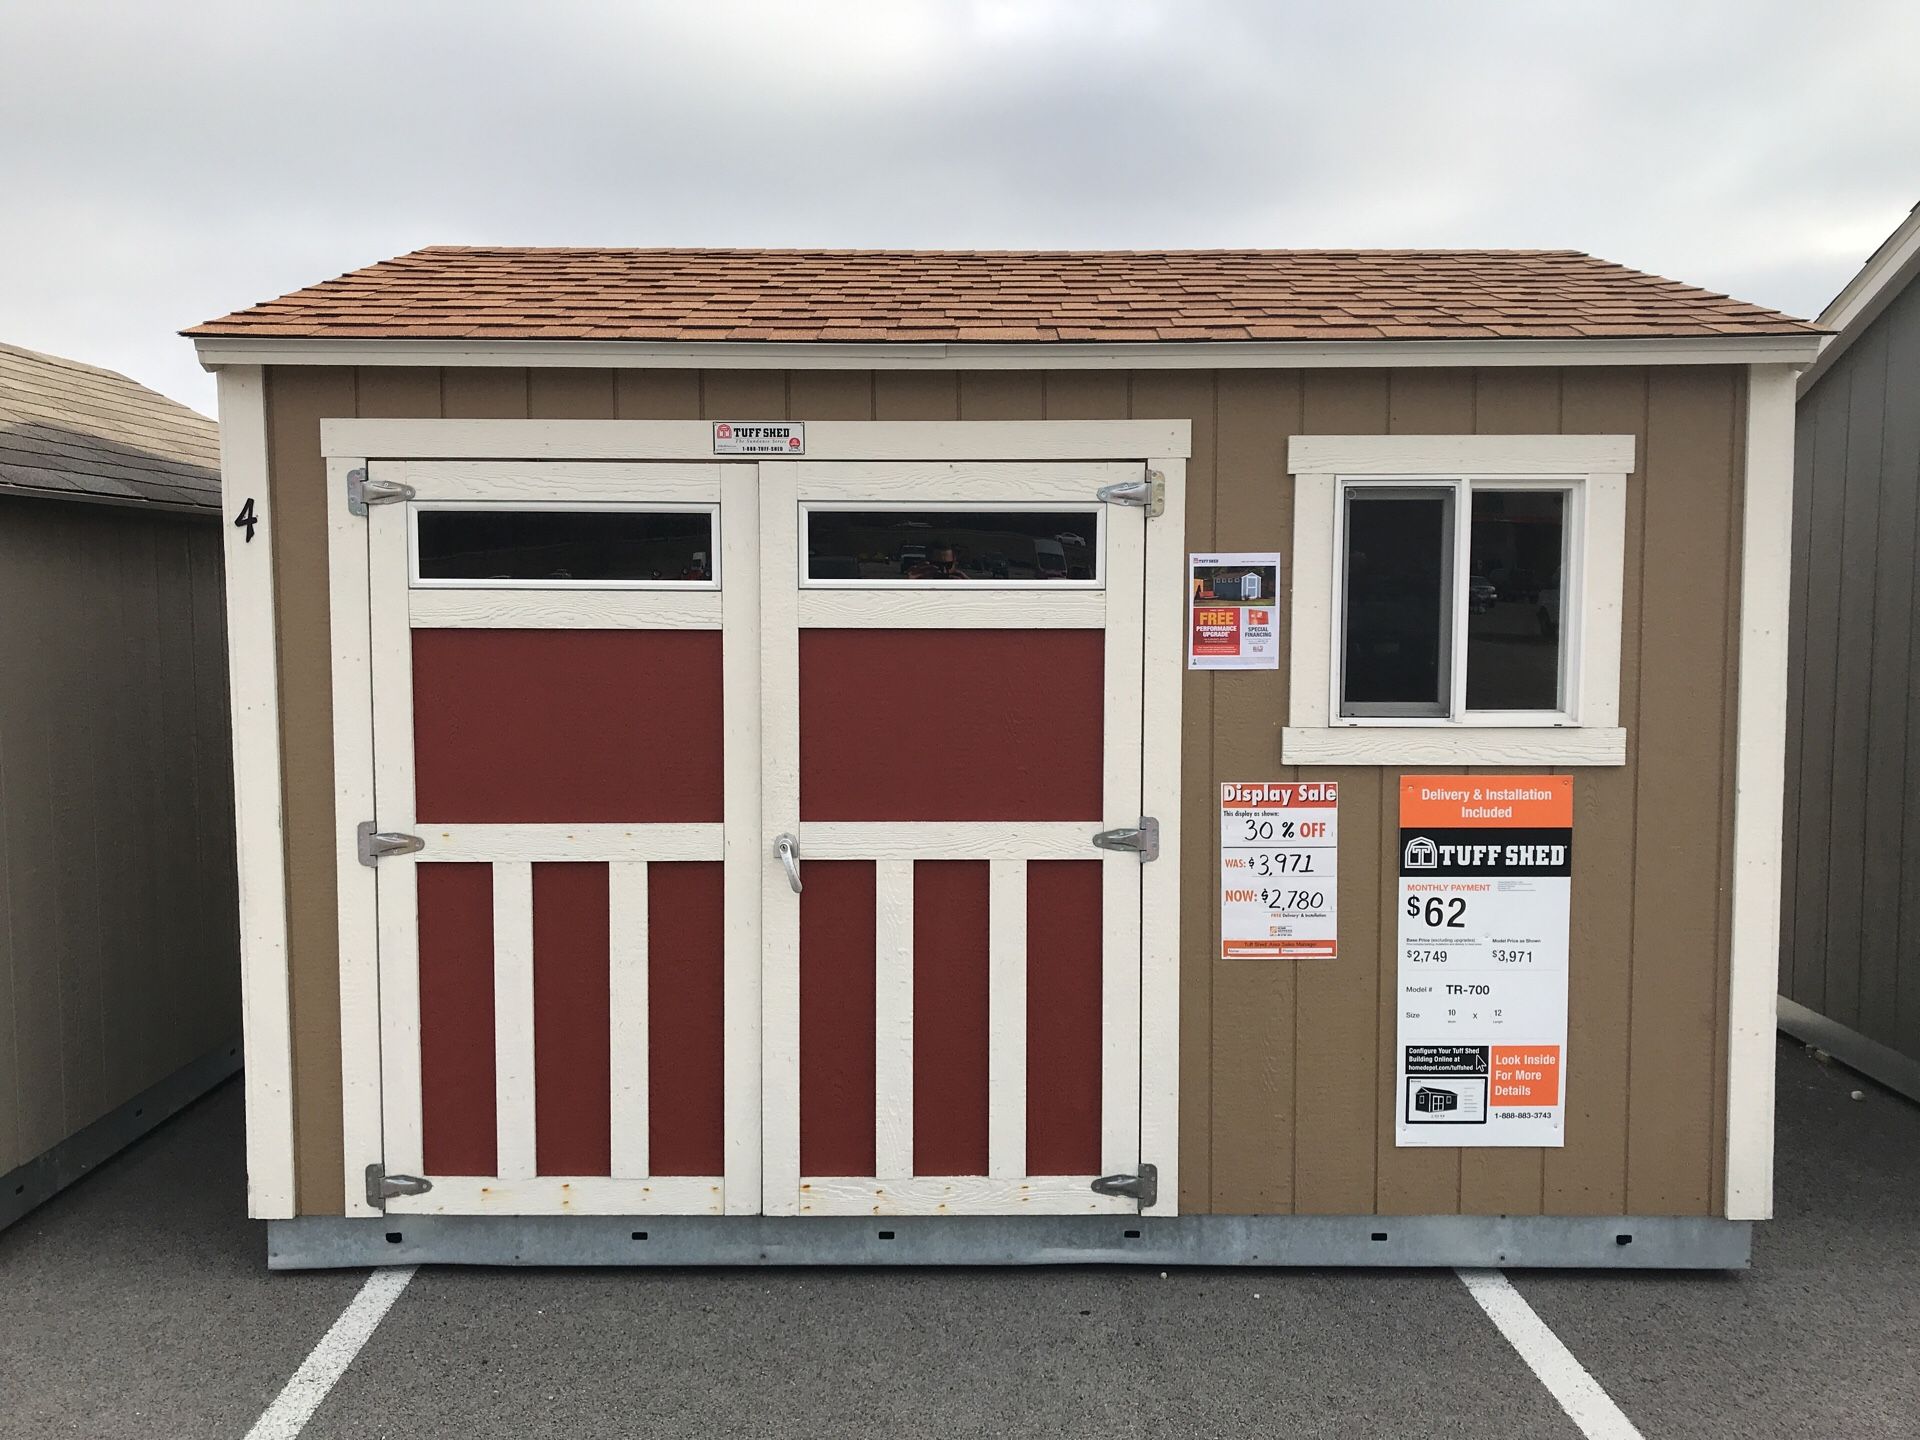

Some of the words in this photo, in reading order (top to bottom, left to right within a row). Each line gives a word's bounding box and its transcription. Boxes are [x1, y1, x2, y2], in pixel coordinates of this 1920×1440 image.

[733, 428, 762, 438] TUFF
[763, 428, 790, 438] SHED
[234, 497, 258, 543] 4
[1199, 612, 1234, 625] FREE
[1223, 784, 1293, 807] Display
[1298, 784, 1337, 803] Sale
[1421, 788, 1470, 803] Delivery
[1473, 788, 1483, 801] &
[1486, 788, 1552, 801] Installation
[1234, 810, 1253, 818] display
[1461, 806, 1512, 818] Included
[1244, 819, 1274, 841] 30
[1281, 821, 1295, 839] %
[1299, 822, 1326, 838] OFF
[1439, 845, 1502, 866] TUFF
[1505, 845, 1565, 866] SHED
[1225, 858, 1246, 868] WAS:
[1407, 884, 1449, 892] MONTHLY
[1450, 884, 1491, 892] PAYMENT
[1225, 889, 1258, 903] NOW:
[1406, 894, 1467, 928] $62
[1406, 950, 1448, 963] $2,749
[1492, 950, 1532, 963] $3,971
[1446, 984, 1490, 995] TR-700
[1448, 1009, 1457, 1017] 10
[1494, 1009, 1502, 1017] 12
[1408, 1047, 1437, 1055] Configure
[1495, 1055, 1521, 1065] Look
[1524, 1055, 1556, 1065] Inside
[1495, 1070, 1511, 1080] For
[1515, 1070, 1542, 1081] More
[1495, 1085, 1531, 1096] Details
